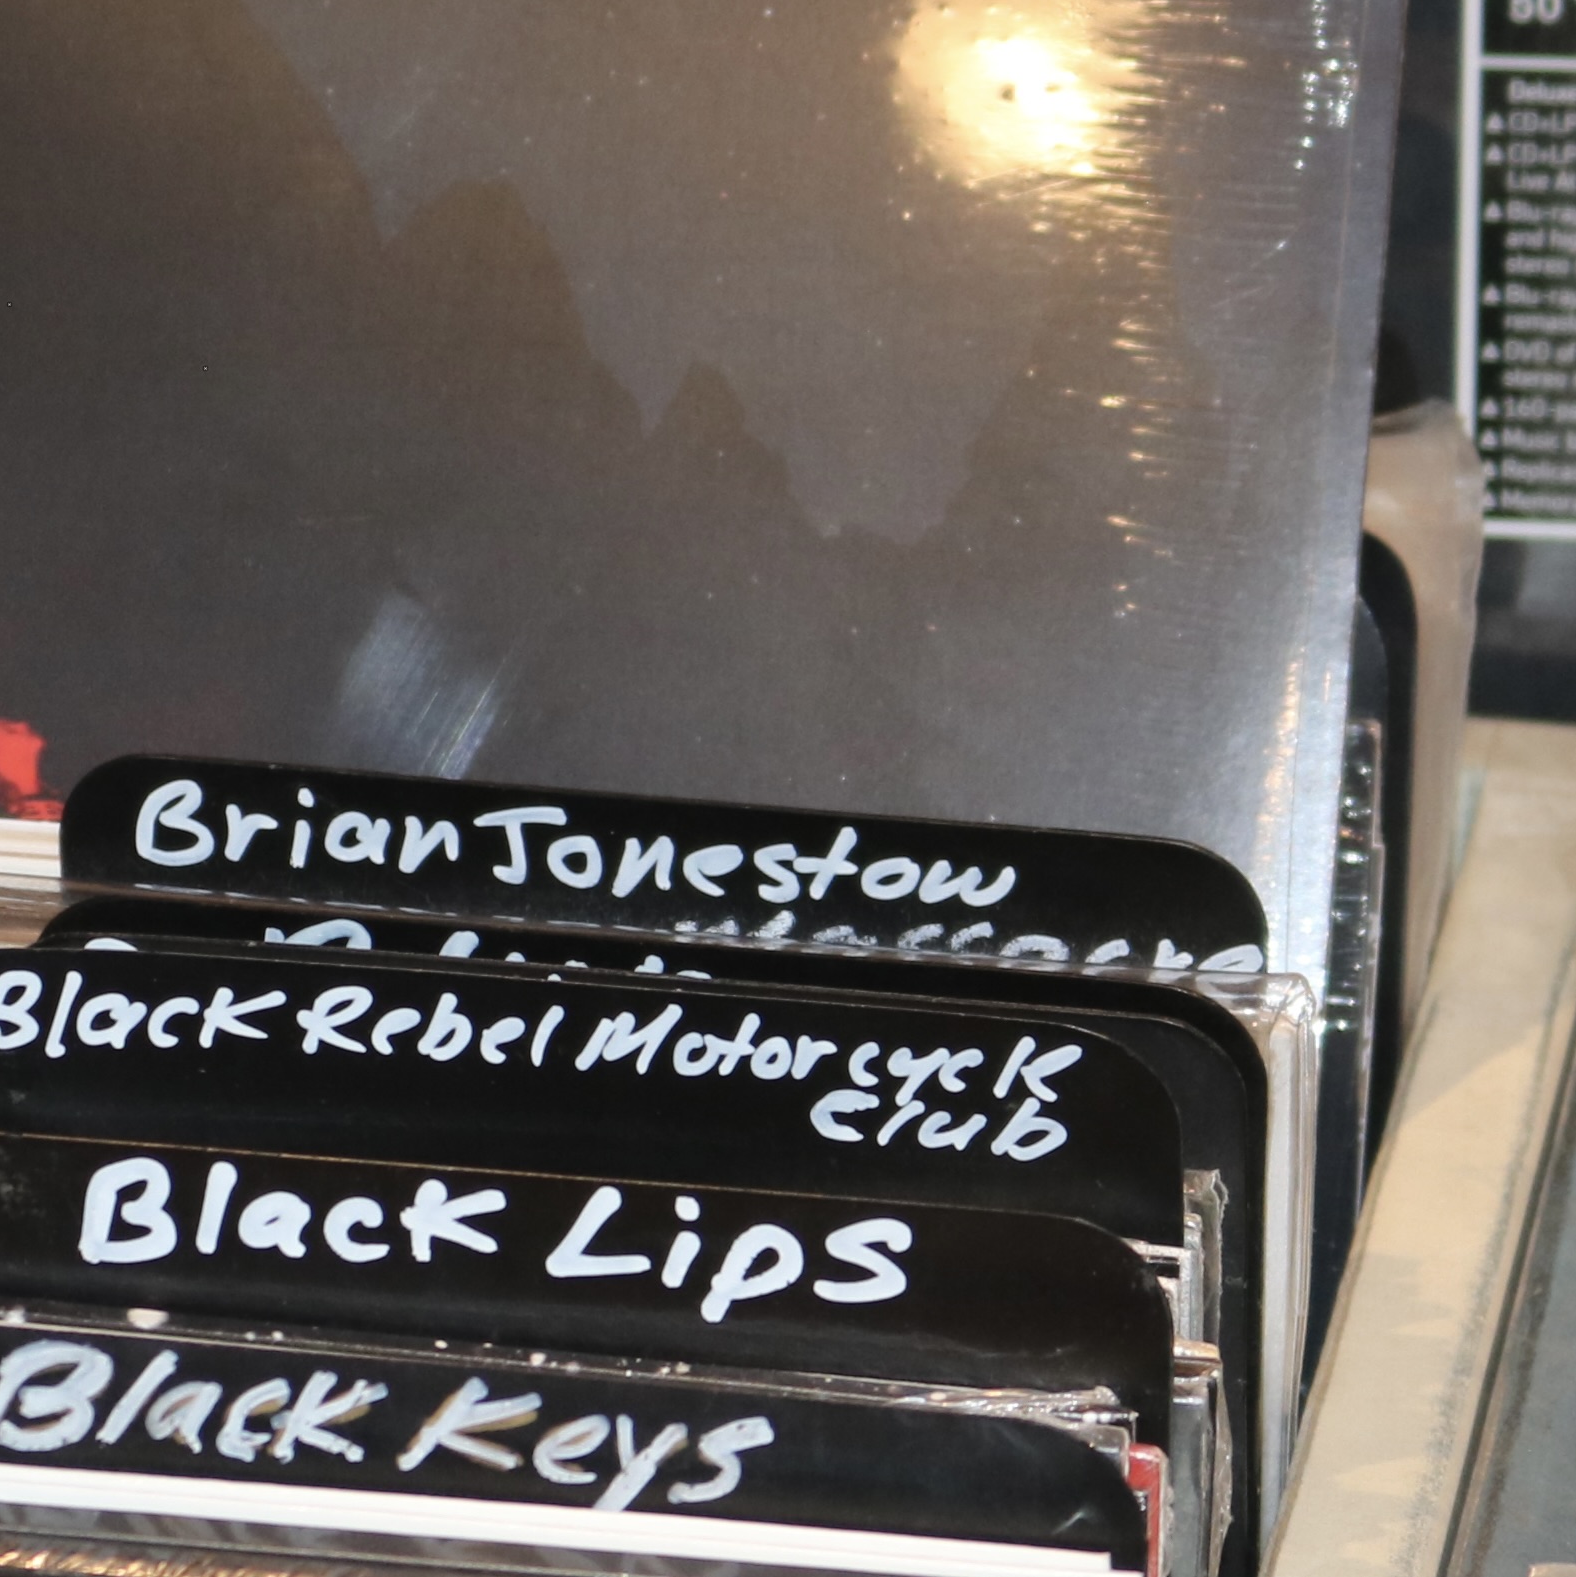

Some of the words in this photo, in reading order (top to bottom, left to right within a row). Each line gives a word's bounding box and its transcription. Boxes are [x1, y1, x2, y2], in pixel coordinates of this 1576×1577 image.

[134, 778, 460, 875] Brian
[295, 985, 560, 1073] Rebel
[809, 1088, 1068, 1163] Club
[78, 1158, 507, 1269] Black
[544, 1179, 914, 1326] Lips
[395, 1374, 776, 1514] Keys
